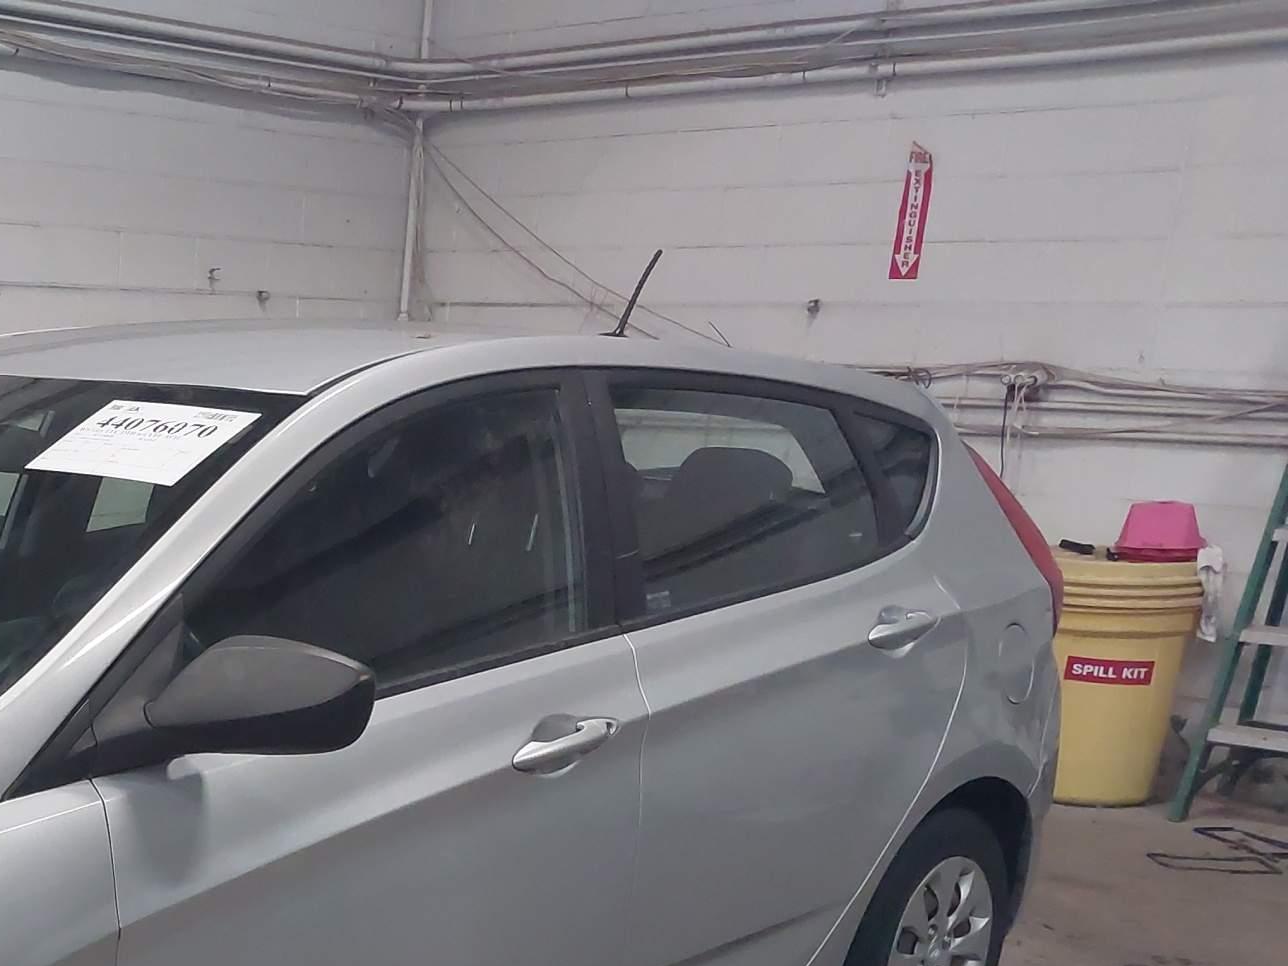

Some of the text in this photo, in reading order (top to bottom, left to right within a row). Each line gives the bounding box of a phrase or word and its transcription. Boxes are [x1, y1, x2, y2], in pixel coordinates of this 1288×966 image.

[900, 169, 923, 268] EXTINGUISHER
[96, 415, 219, 439] 44076070
[1071, 663, 1149, 680] SPILL KIT
